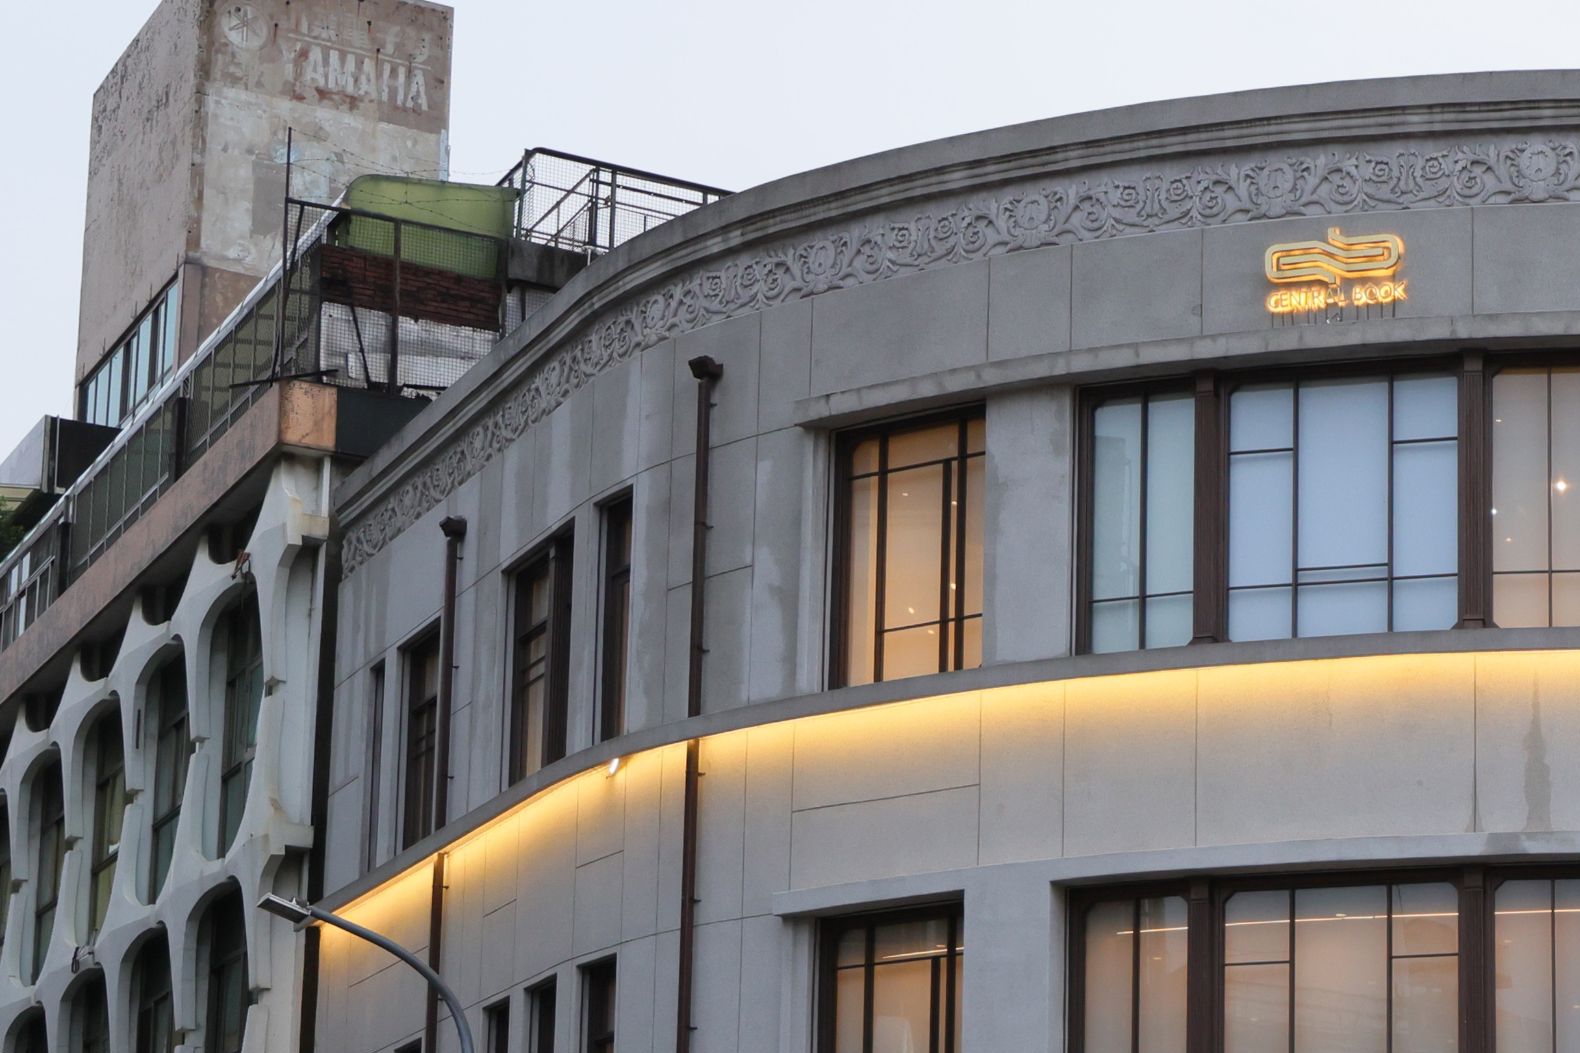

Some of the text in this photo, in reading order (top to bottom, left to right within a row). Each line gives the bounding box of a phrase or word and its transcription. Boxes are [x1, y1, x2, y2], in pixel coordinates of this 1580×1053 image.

[280, 40, 429, 111] YAMAHA
[1268, 280, 1407, 312] CENTRAL BOOK
